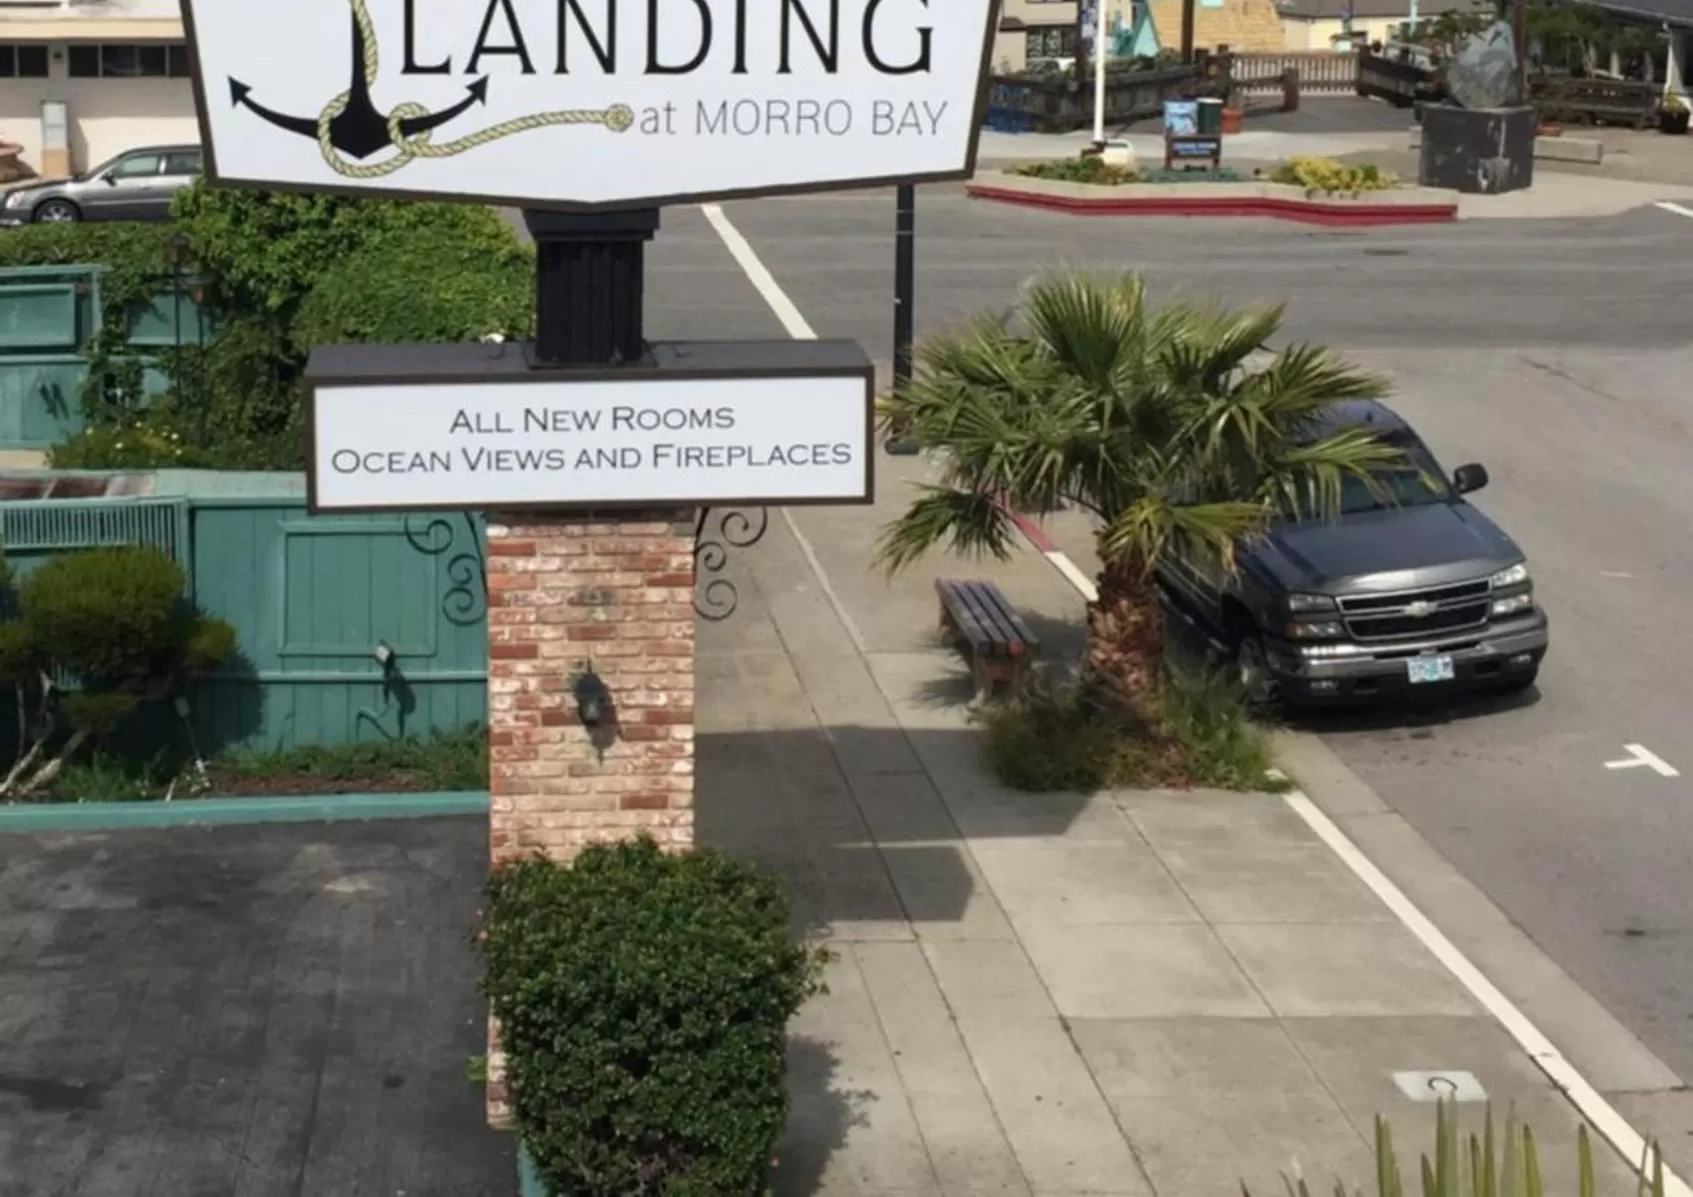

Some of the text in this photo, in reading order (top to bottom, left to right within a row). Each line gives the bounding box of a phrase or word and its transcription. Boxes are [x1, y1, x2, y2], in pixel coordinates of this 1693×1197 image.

[640, 99, 948, 136] at MORRO BAY
[449, 406, 735, 434] ALL NEW ROOMS
[331, 443, 852, 474] OCEAN VIEWS AND FIREPLACES
